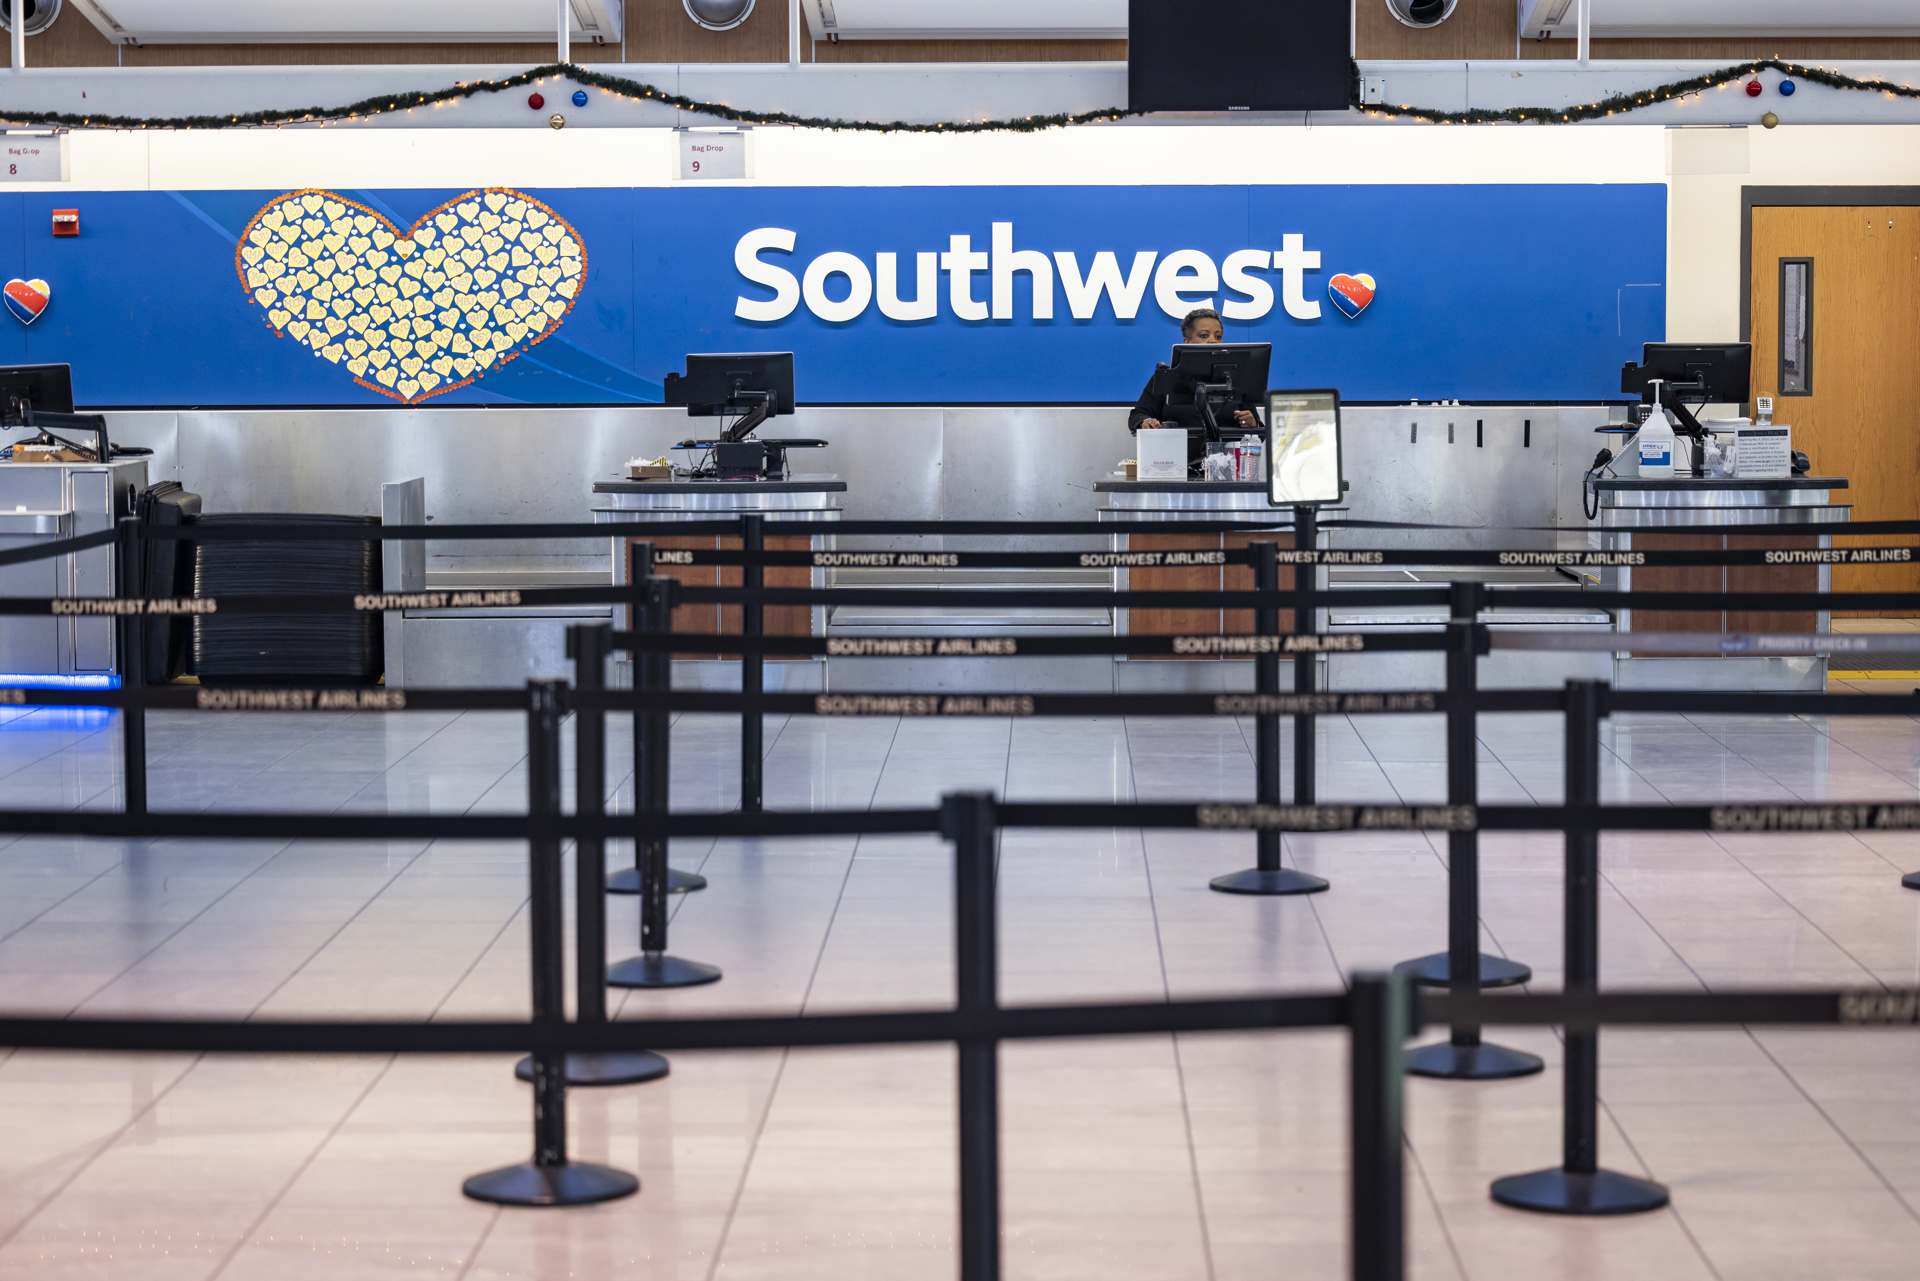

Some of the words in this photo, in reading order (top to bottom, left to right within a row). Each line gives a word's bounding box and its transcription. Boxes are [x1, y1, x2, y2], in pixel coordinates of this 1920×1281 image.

[9, 164, 17, 174] 8
[692, 161, 700, 172] 9
[304, 198, 321, 208] SAT
[458, 206, 476, 215] TUS
[356, 218, 374, 228] SMF
[481, 214, 499, 225] BUR
[306, 222, 321, 231] LIT
[280, 228, 298, 238] CLT
[416, 230, 434, 242] PDX
[463, 230, 479, 239] BOI
[327, 238, 342, 246] ISP
[350, 240, 369, 249] CVG
[446, 238, 462, 250] SJD
[522, 236, 540, 246] AUS
[268, 245, 285, 254] GSP
[305, 242, 322, 254] JAX
[396, 243, 413, 252] BWI
[244, 250, 262, 260] AMA
[368, 254, 384, 263] PUJ
[426, 250, 442, 260] CLE
[463, 252, 481, 261] LGB
[540, 250, 556, 258] IAD
[266, 264, 284, 275] RSW
[318, 262, 334, 272] SFO
[446, 262, 462, 274] SJC
[734, 221, 1322, 321] Southwest
[248, 270, 265, 284] OMA
[357, 270, 374, 280] SDF
[382, 268, 400, 278] ROC
[476, 272, 493, 281] SNA
[542, 270, 560, 280] DSM
[298, 274, 316, 286] BNA
[335, 278, 352, 288] STL
[426, 275, 442, 284] BDL
[278, 280, 296, 291] PVR
[401, 282, 417, 292] LIR
[502, 283, 520, 294] BOS
[256, 292, 276, 300] MHT
[354, 290, 372, 300] ORF
[480, 295, 498, 304] LGA
[530, 290, 548, 300] RNO
[284, 297, 306, 309] MEM
[332, 302, 354, 312] PWM
[416, 300, 432, 313] LBB
[512, 302, 533, 311] GCM
[372, 308, 388, 318] PLS
[392, 304, 410, 313] TUL
[548, 304, 563, 314] ICT
[272, 312, 286, 322] FLL
[440, 310, 458, 322] MKE
[468, 312, 486, 322] BHM
[326, 320, 344, 330] CRP
[351, 316, 368, 328] RDU
[414, 320, 432, 332] DCA
[291, 325, 308, 334] RIC
[392, 322, 410, 334] PVD
[508, 326, 526, 334] NAS
[366, 332, 384, 342] SAN
[434, 332, 450, 342] LAS
[472, 332, 488, 342] MSY
[348, 342, 365, 351] IND
[393, 342, 410, 352] LAX
[418, 344, 434, 352] ALB
[325, 346, 342, 358] PNS
[370, 352, 389, 362] ONT
[476, 352, 497, 360] DTW
[349, 360, 368, 372] TPA
[402, 361, 420, 369] AUA
[436, 360, 450, 370] PIT
[456, 362, 474, 371] MCO
[400, 382, 416, 392] DAL
[655, 551, 693, 564] LINES
[814, 553, 895, 566] SOUTHWEST
[897, 553, 958, 566] AIRLINES
[1079, 553, 1163, 567] SOUTHWEST
[1164, 551, 1226, 565] AIRLINES
[1276, 551, 1321, 564] HWEST
[1322, 551, 1383, 565] AIRLINES
[1499, 551, 1585, 564] SOUTHWEST
[1584, 552, 1645, 565] AIRLINES
[1765, 550, 1849, 564] SOUTHWEST
[1850, 548, 1911, 562] AIRLINES
[354, 593, 449, 610] SOUTHWEST
[451, 590, 521, 606] AIRLINES
[51, 599, 146, 615] SOUTHWEST
[147, 598, 217, 614] AIRLINES
[826, 638, 936, 656] SOUTHWEST
[936, 638, 1017, 655] AIRLINES
[1173, 637, 1281, 654] SOUTHWEST
[1283, 633, 1364, 651] AIRLINES
[197, 689, 316, 709] SOUTHWEST
[317, 690, 406, 710] AIRLINES
[1214, 695, 1338, 715] SOUTHWEST
[1343, 692, 1436, 711] AIRLINES
[816, 695, 939, 716] SOUTHWEST
[942, 695, 1035, 716] AIRLINES
